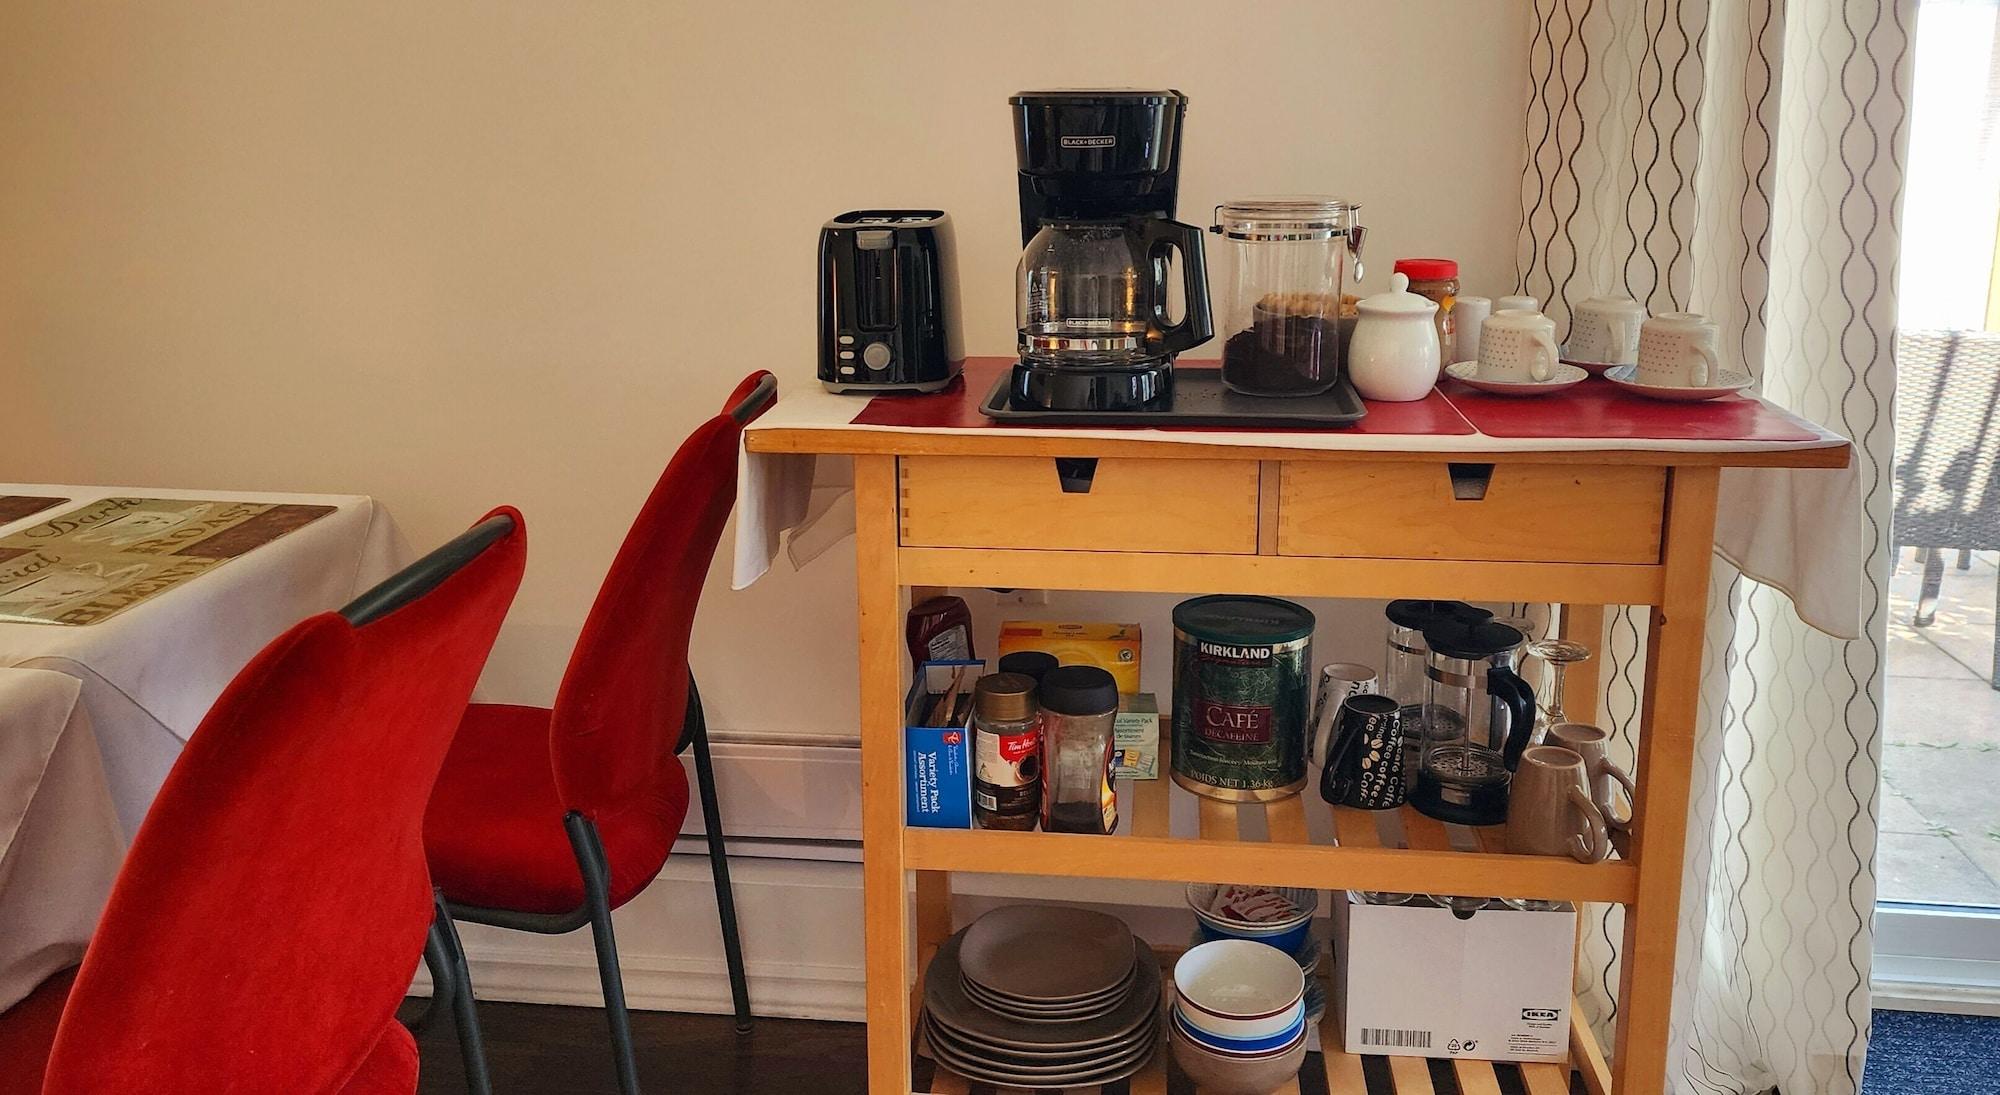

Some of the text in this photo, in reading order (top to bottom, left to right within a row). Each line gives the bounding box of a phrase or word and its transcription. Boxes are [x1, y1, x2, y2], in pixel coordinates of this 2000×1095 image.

[1200, 642, 1270, 659] KIRKLAND
[1206, 706, 1259, 729] CAFÉ
[1008, 741, 1022, 751] Tim
[1383, 720, 1400, 759] Coffee
[917, 751, 929, 813] Assortiment
[927, 751, 940, 814] Variety Pack
[1190, 770, 1217, 785] POIDS
[1219, 777, 1239, 788] NET
[1370, 761, 1388, 798] coffee
